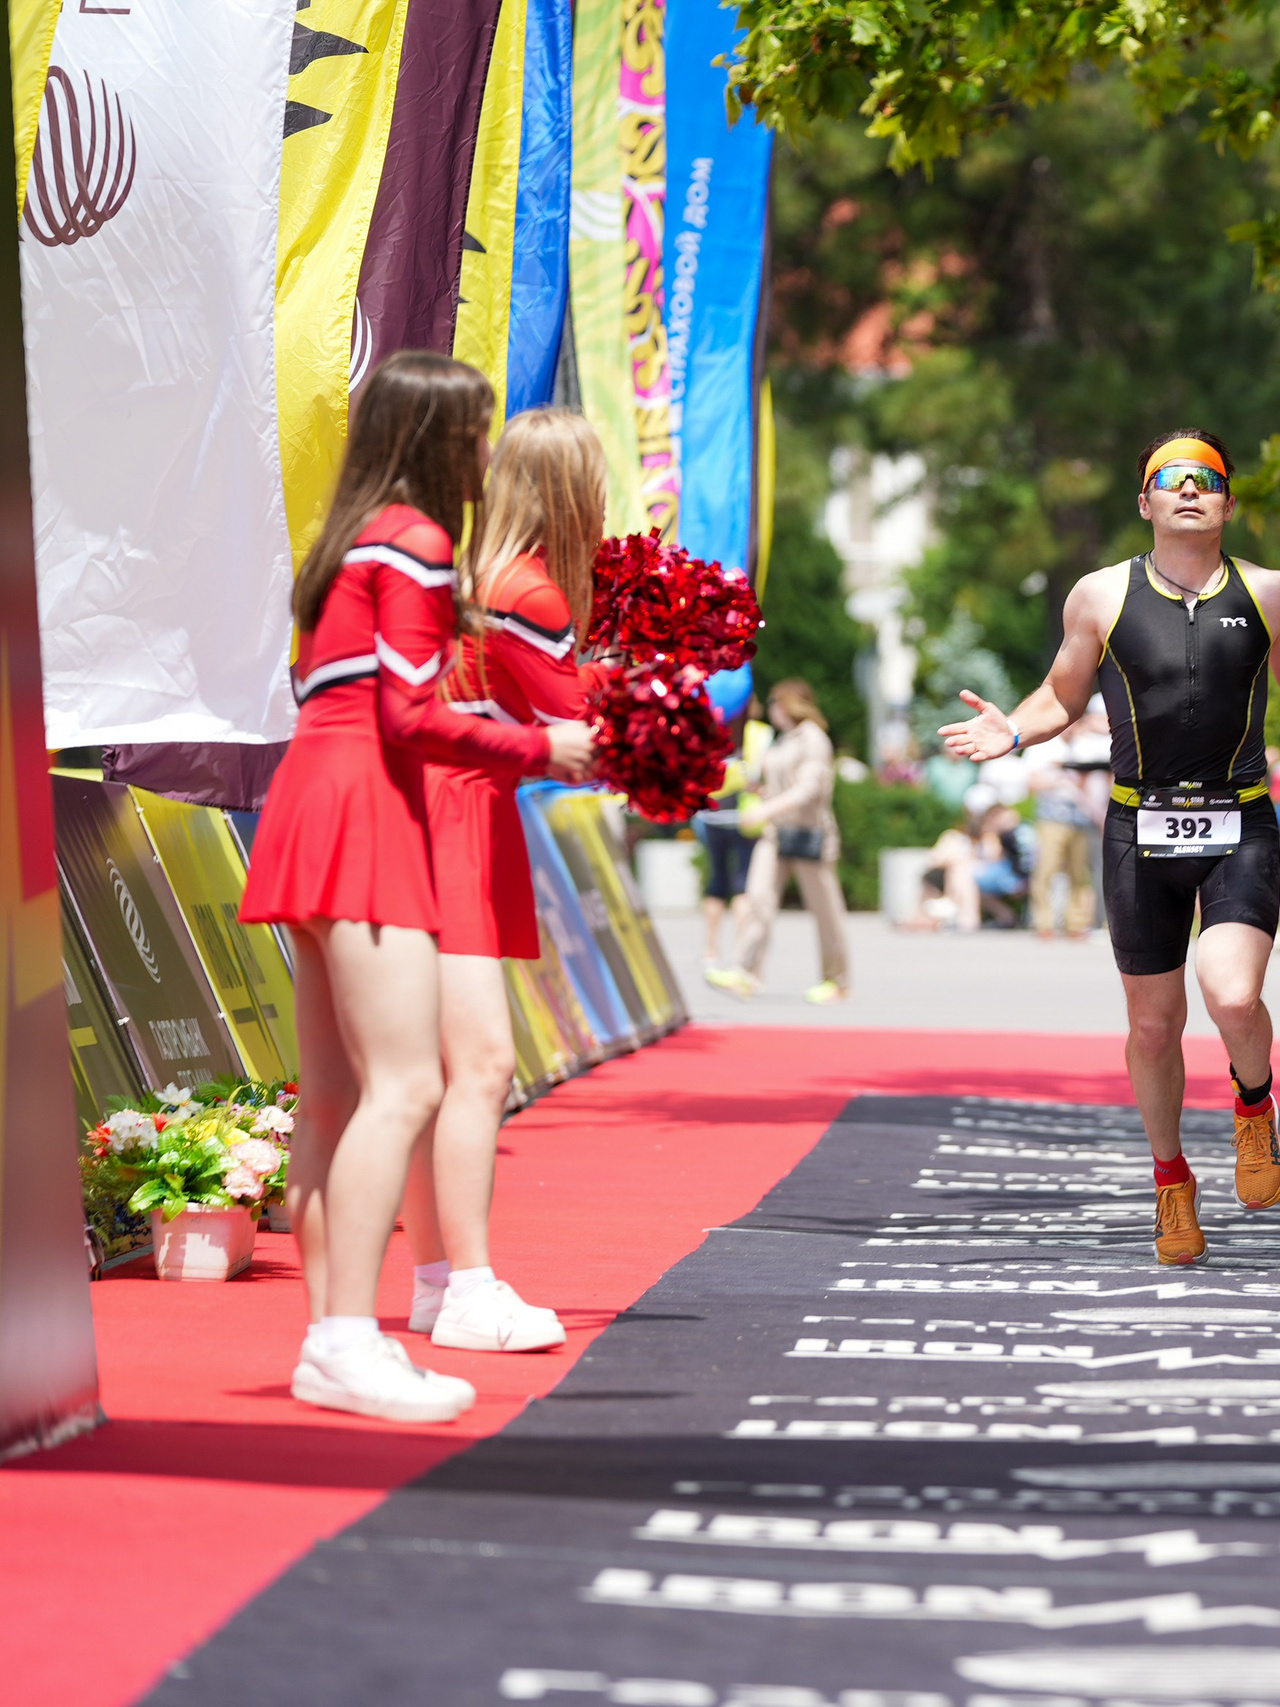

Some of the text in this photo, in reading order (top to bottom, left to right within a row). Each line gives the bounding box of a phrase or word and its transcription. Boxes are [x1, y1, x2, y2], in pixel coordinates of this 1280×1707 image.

[683, 157, 714, 229] ДОМ
[667, 231, 703, 399] СТРАХОВОЙ
[1220, 617, 1248, 628] TYR
[1165, 817, 1212, 839] 392
[836, 1278, 1100, 1291] IRON
[794, 1337, 1094, 1358] IRON
[733, 1419, 1083, 1438] IRON
[645, 1509, 1064, 1546] IRON
[592, 1567, 1052, 1615] IRON
